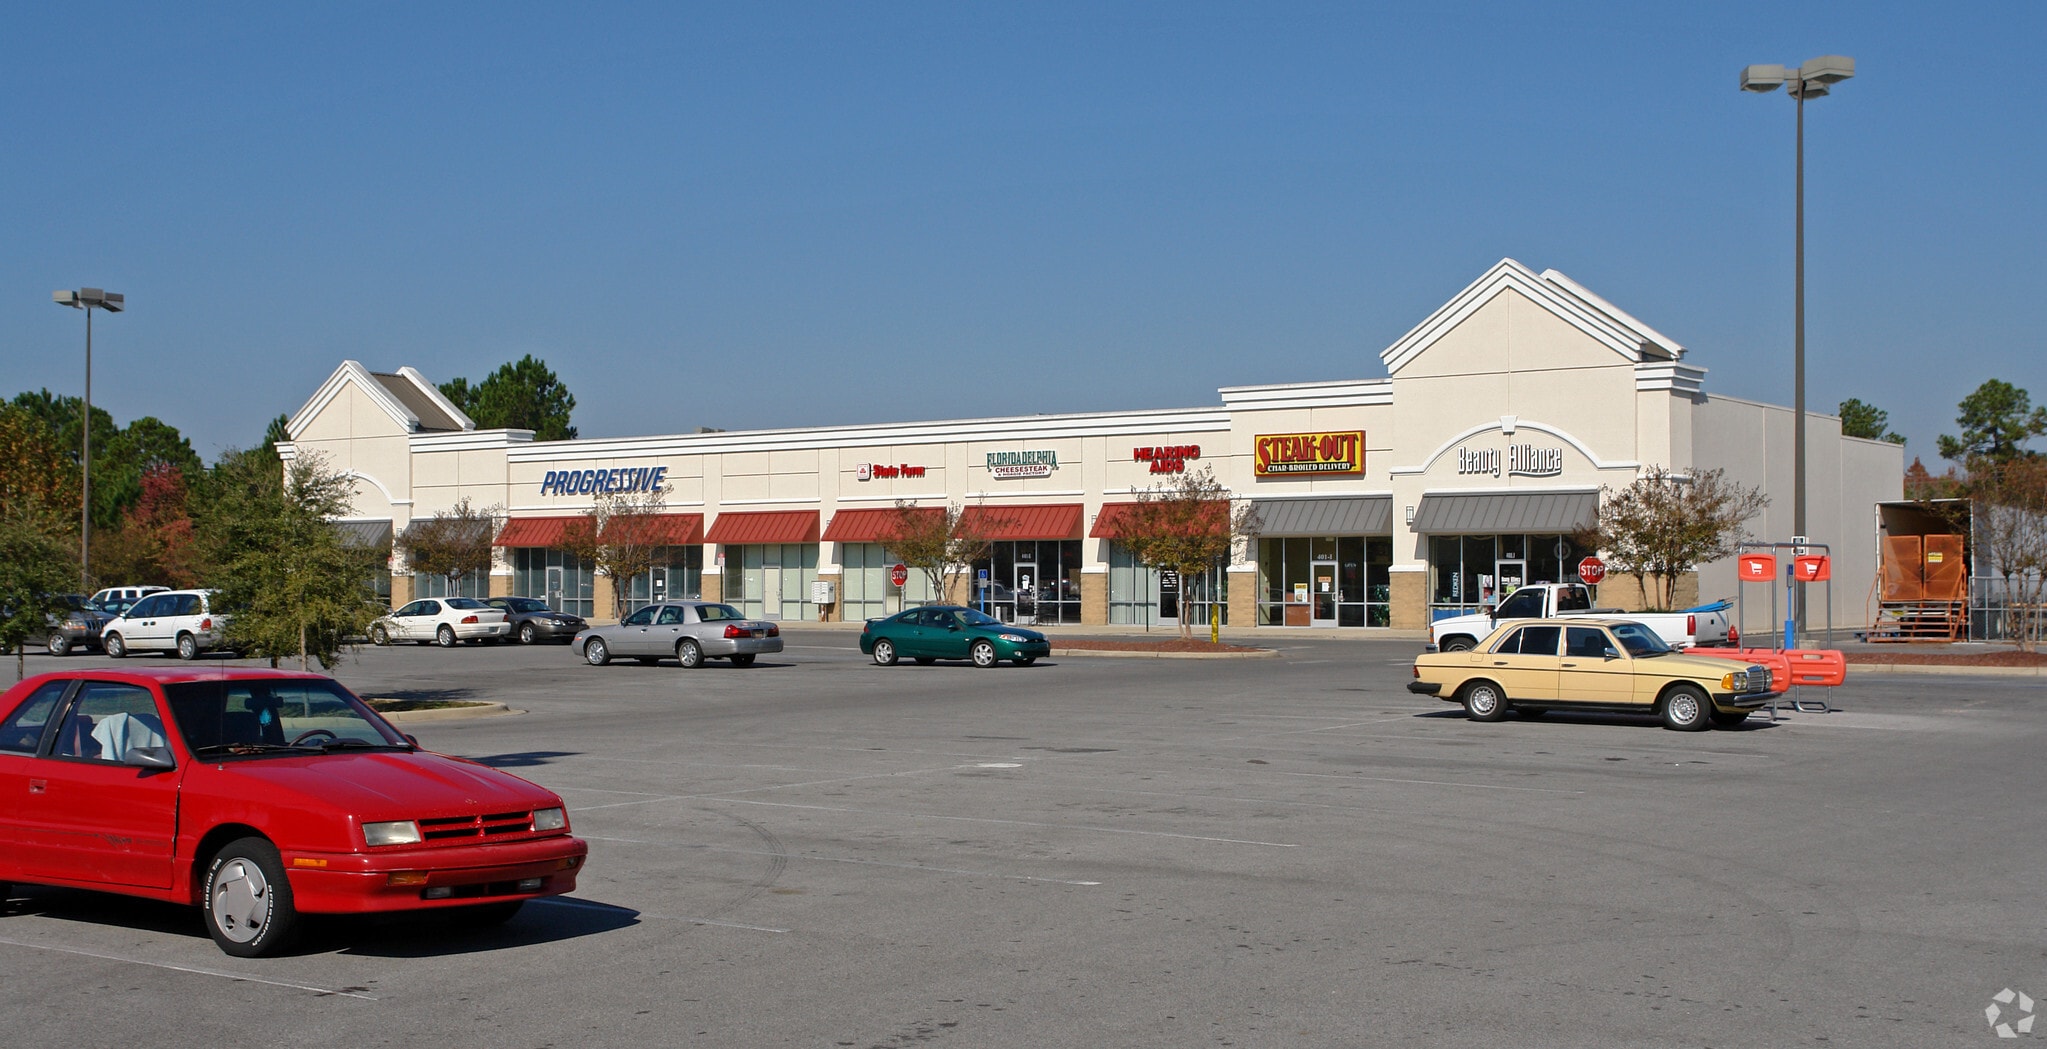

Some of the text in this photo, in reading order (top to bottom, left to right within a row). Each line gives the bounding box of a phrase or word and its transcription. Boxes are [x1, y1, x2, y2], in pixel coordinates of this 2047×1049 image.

[986, 450, 1059, 471] FLORIDADELPHIA
[1133, 445, 1200, 461] HEARING
[1257, 433, 1359, 473] STEAK-OUT
[1458, 445, 1562, 477] Beauty Alliance
[873, 464, 925, 479] State Farm
[995, 465, 1048, 474] CHEESESTEAK
[1149, 459, 1185, 475] AIDS
[1267, 462, 1351, 472] CHAR-BROILED DELIVERY
[540, 466, 669, 496] PROGRESSIVE
[892, 570, 907, 580] STOP
[1581, 565, 1604, 576] STOP
